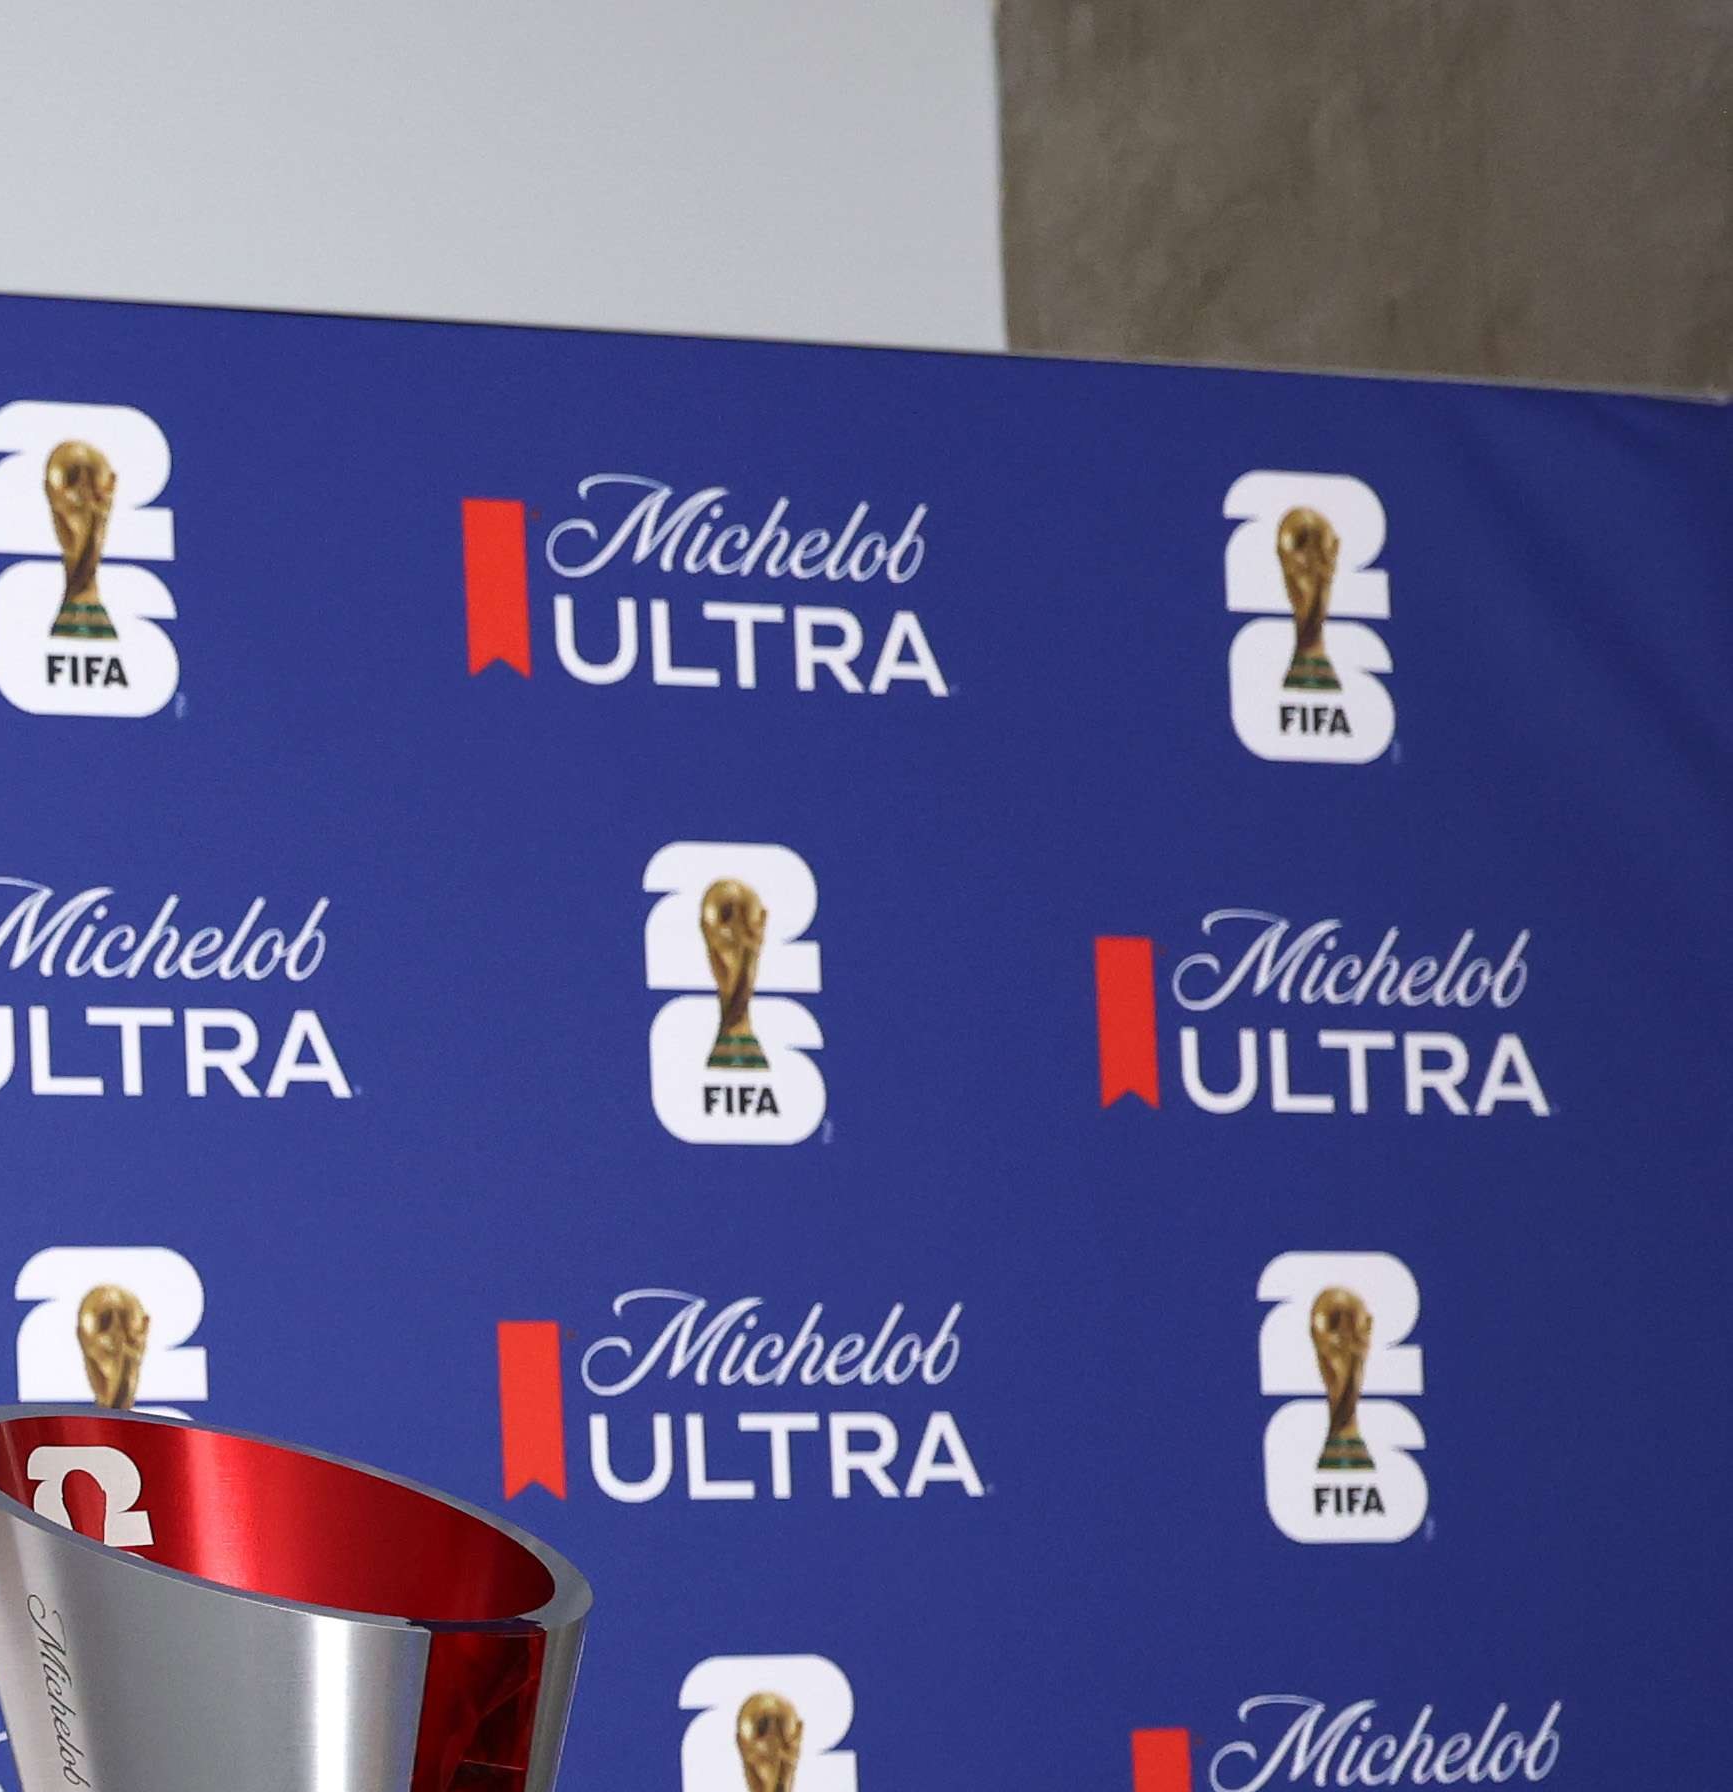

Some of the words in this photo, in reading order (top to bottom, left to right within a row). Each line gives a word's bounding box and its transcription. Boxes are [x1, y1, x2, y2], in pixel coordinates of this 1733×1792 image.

[546, 475, 926, 583] Michelob
[46, 655, 129, 687] FIFA
[554, 595, 948, 696] ULTRA
[1279, 706, 1351, 734] FIFA
[1173, 910, 1529, 1010] Michelob
[703, 1086, 780, 1115] FIFA
[1180, 1028, 1549, 1116] ULTRA
[582, 1289, 961, 1395] Michelob
[590, 1412, 984, 1502] ULTRA
[1314, 1487, 1385, 1514] FIFA
[26, 1594, 92, 1789] Michelob
